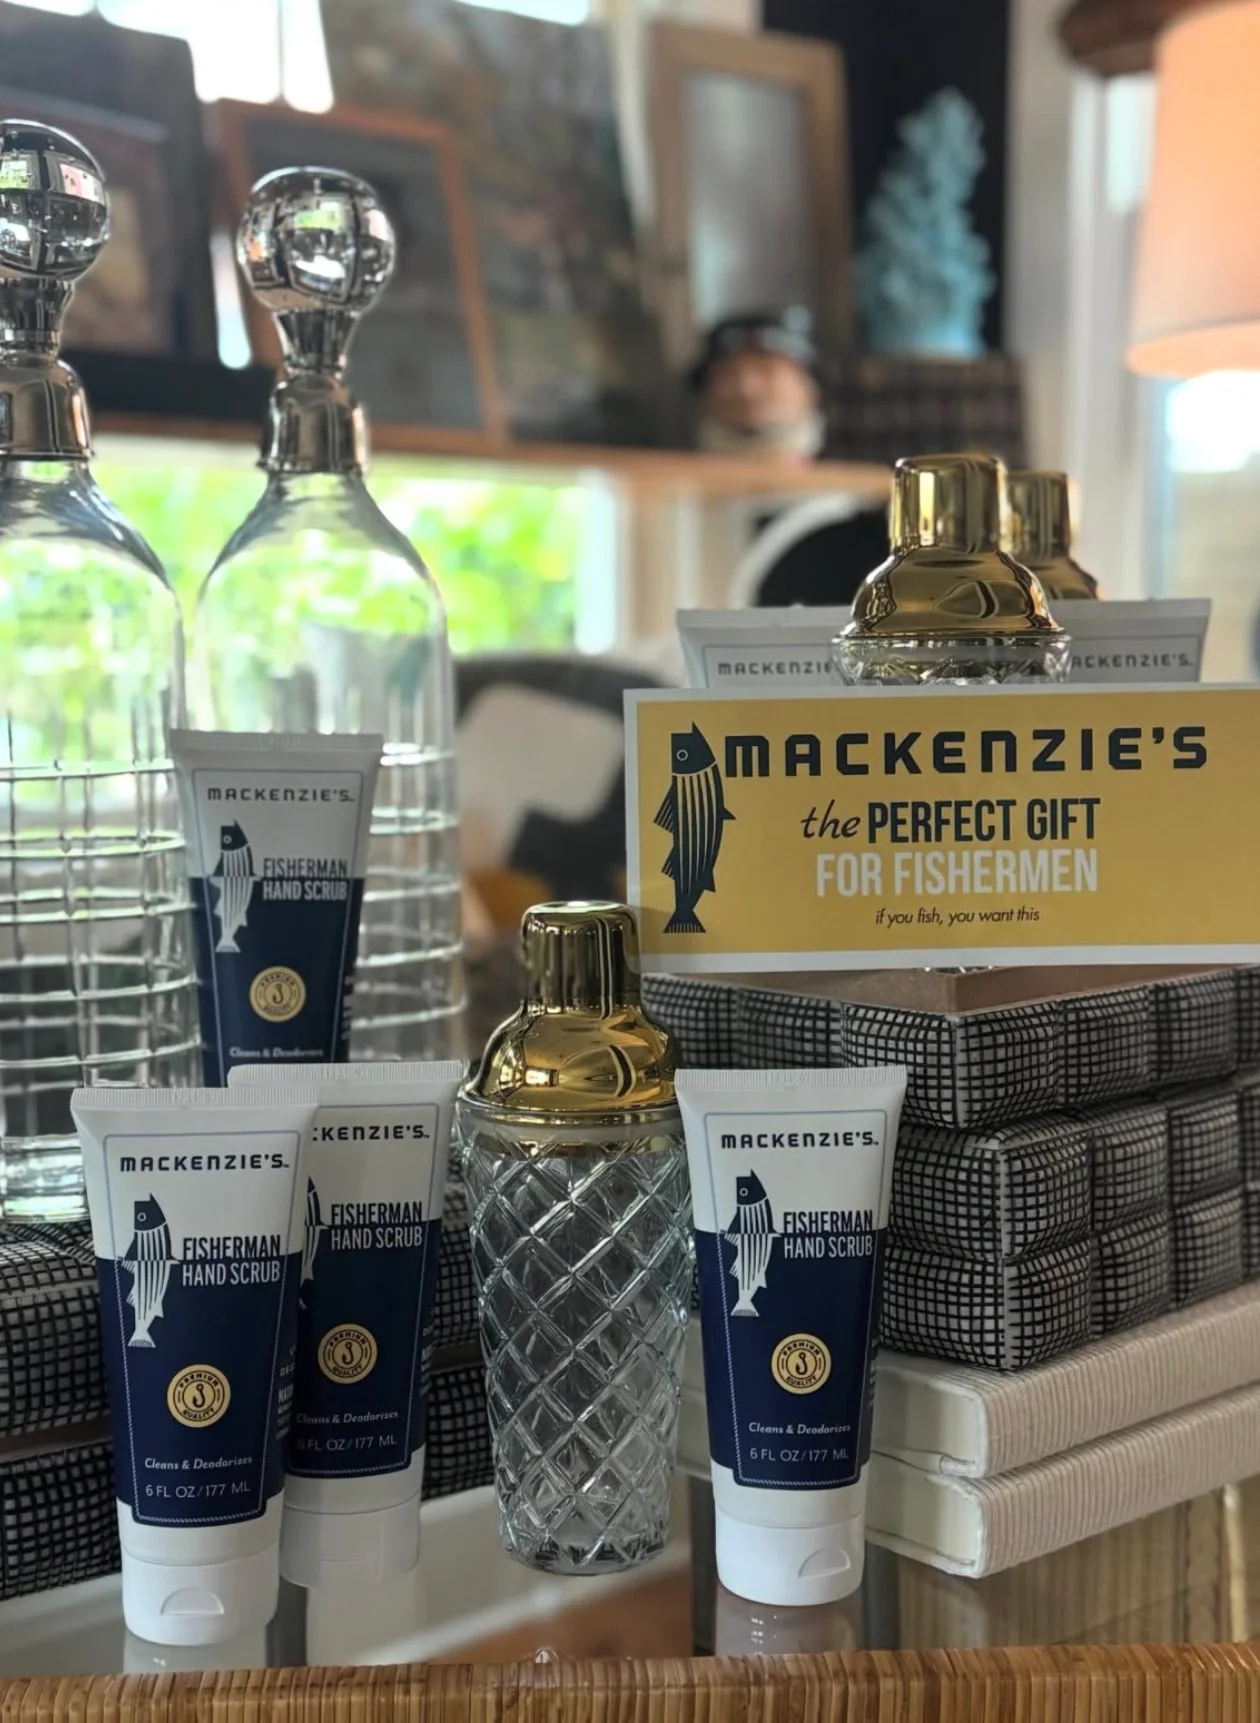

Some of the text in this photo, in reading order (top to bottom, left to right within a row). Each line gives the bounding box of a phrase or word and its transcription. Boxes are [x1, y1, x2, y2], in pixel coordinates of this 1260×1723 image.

[717, 661, 833, 675] MACKENZIE
[1071, 652, 1190, 669] ACKENZIE'S
[724, 726, 1207, 778] MACKENZIE'S
[207, 787, 351, 802] MACKENZIE'S
[800, 797, 1101, 843] the PERFECT GIFT
[263, 857, 348, 878] FISHERMAN
[816, 847, 1098, 897] FOR FISHERMEN
[262, 880, 348, 900] HAND SCRUB
[875, 905, 1040, 928] if you fish, you want this
[313, 1125, 424, 1141] KENZIE'S
[720, 1131, 873, 1149] MACKENZIE'S
[120, 1153, 284, 1172] MACKENZIE'S
[331, 1201, 422, 1226] FISHERMAN
[783, 1209, 873, 1233] FISHERMAN
[183, 1234, 281, 1260] FISHERMAN
[331, 1226, 422, 1250] HAND SCRUB
[784, 1235, 873, 1259] HAND SCRUB
[182, 1260, 281, 1287] HAND SCRUB
[332, 1414, 340, 1424] &
[748, 1422, 851, 1435] Cleans & Deodorizes
[308, 1439, 322, 1451] FL
[379, 1434, 398, 1447] ML
[144, 1457, 179, 1470] Cleans
[181, 1459, 191, 1470] &
[750, 1448, 758, 1460] 6
[761, 1448, 776, 1461] FL
[833, 1448, 849, 1460] ML
[145, 1484, 154, 1497] 6
[156, 1485, 171, 1498] FL
[231, 1480, 251, 1495] ML
